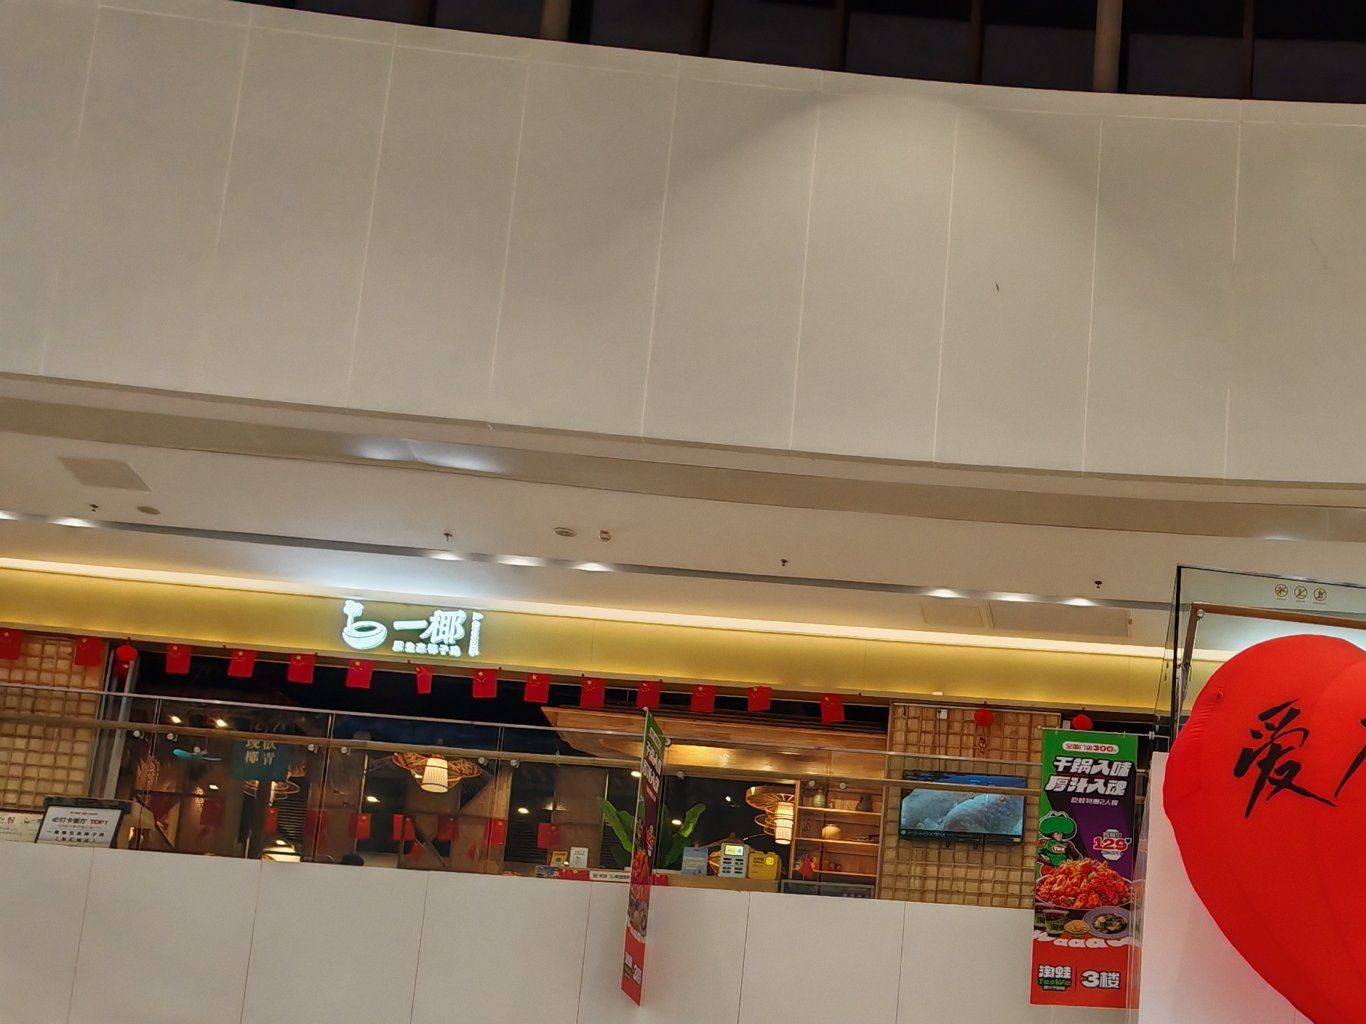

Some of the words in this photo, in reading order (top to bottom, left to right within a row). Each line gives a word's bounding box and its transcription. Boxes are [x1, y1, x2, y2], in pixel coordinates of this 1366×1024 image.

[393, 609, 467, 645] 一椰
[1053, 756, 1132, 777] 干锅入味
[1045, 775, 1128, 796] 厚汁入魂
[1093, 837, 1128, 851] 129
[1038, 965, 1071, 979] 淘蛙
[1081, 970, 1120, 989] 3楼
